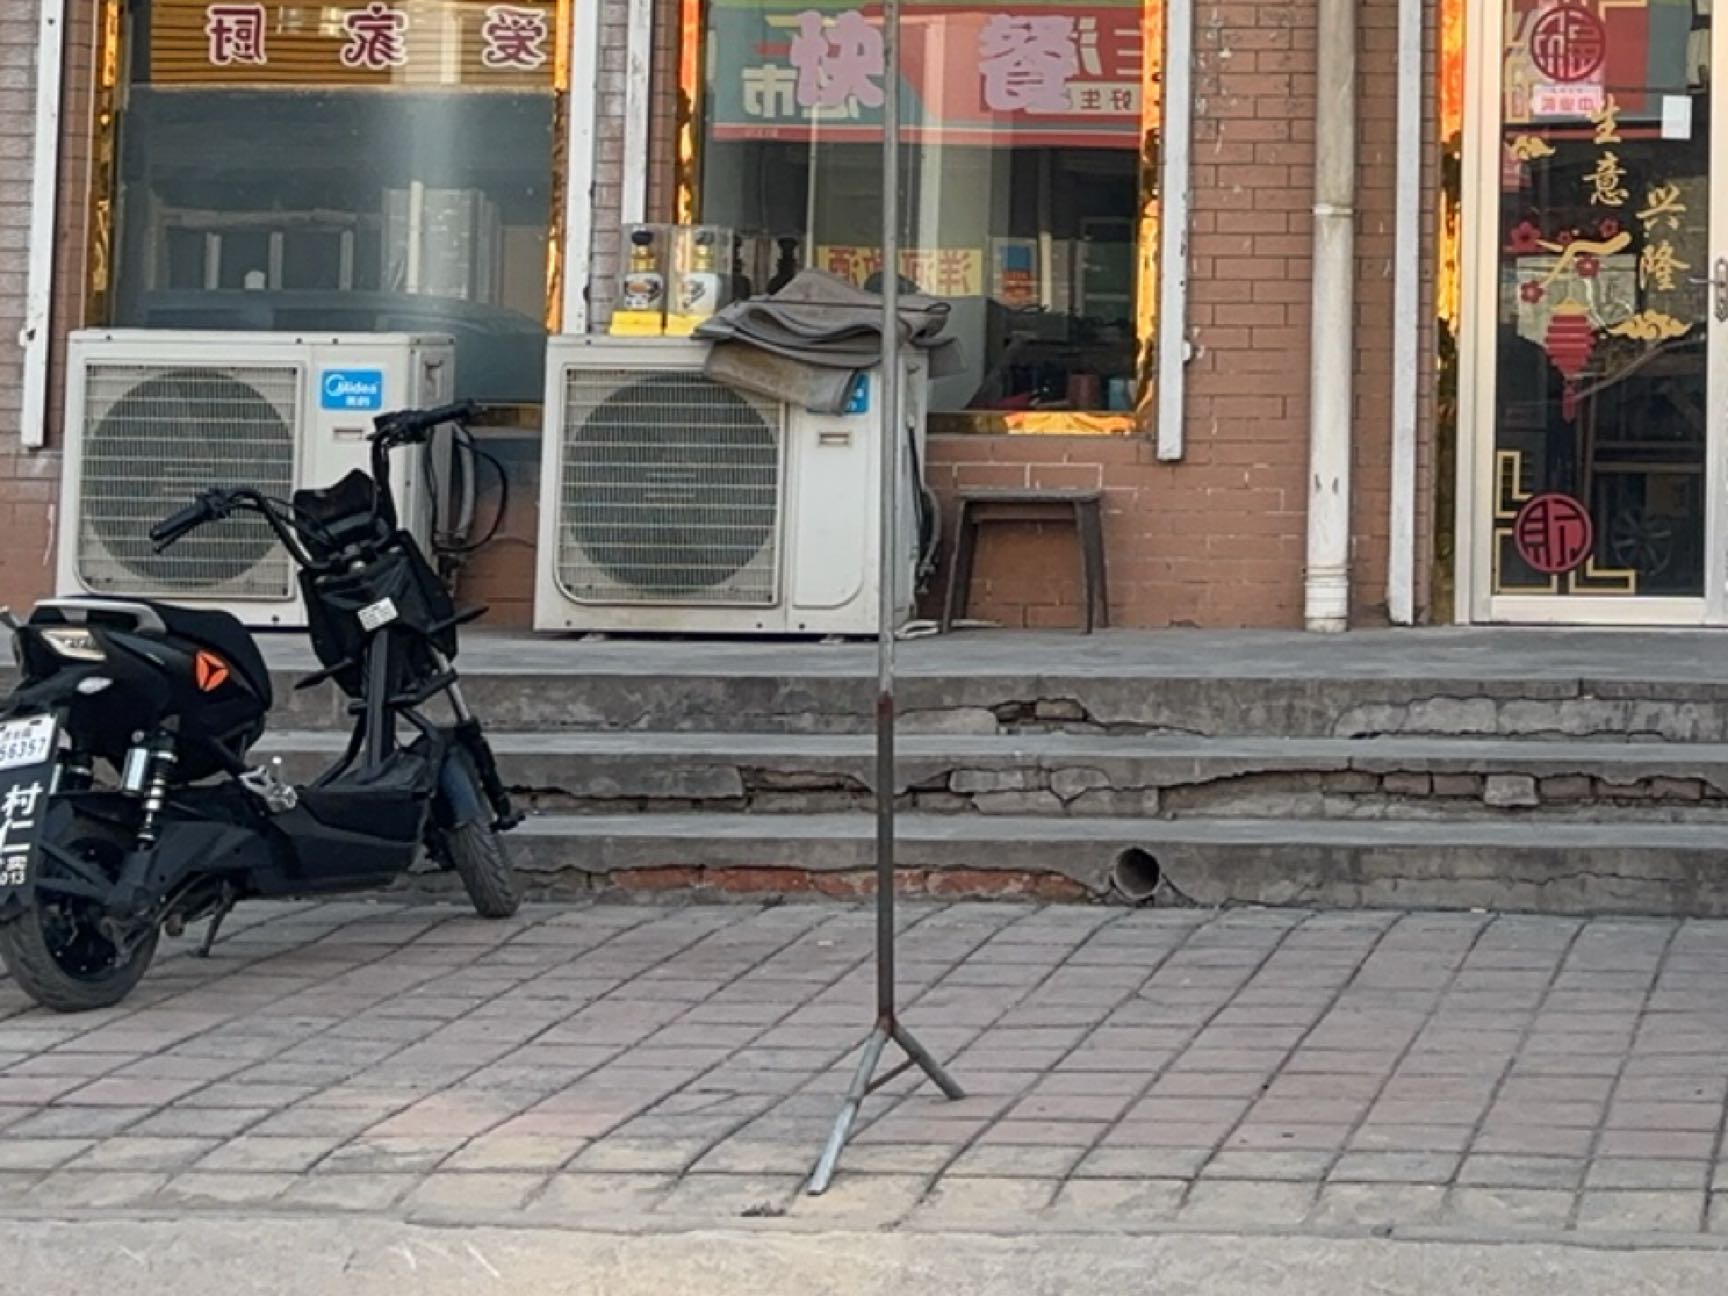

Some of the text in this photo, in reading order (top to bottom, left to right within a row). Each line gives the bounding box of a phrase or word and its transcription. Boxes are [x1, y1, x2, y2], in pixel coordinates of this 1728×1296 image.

[790, 9, 1077, 111] 快餐
[1582, 93, 1630, 206] 生意
[1636, 182, 1691, 291] 兴隆
